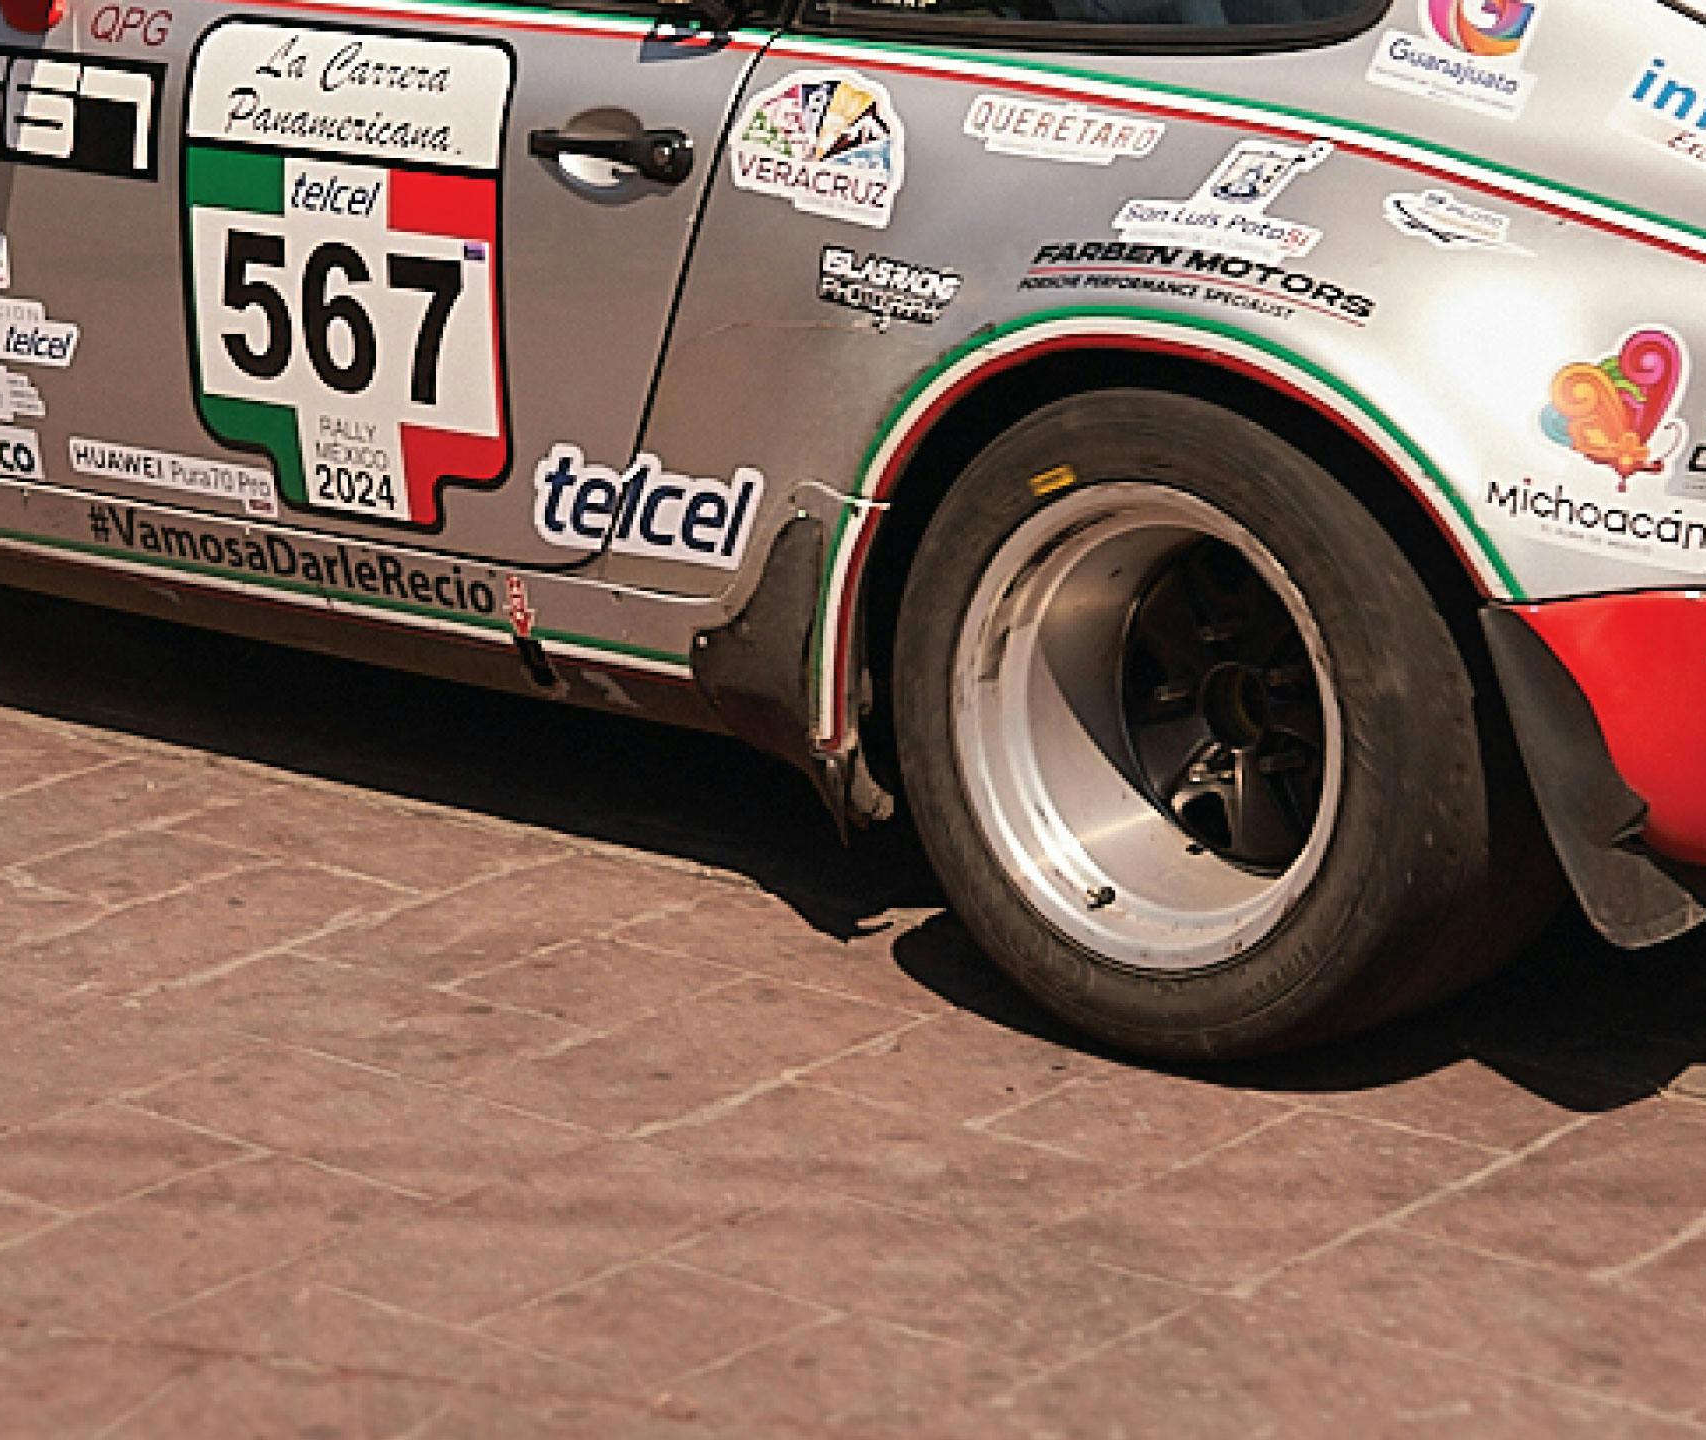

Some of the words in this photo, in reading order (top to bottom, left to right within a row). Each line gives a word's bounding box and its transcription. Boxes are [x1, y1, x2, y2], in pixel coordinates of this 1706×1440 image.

[91, 6, 173, 47] QPG
[255, 35, 307, 78] La
[320, 41, 451, 92] Carrera
[1389, 37, 1519, 96] Guanajuato
[291, 172, 381, 218] telcel
[738, 150, 888, 209] VERACRUZ
[1030, 242, 1184, 266] FARBEN
[1181, 248, 1376, 318] MOTORS
[5, 325, 76, 359] telcel
[221, 228, 462, 405] 567
[75, 445, 162, 480] HUAWEI
[314, 463, 395, 511] 2024
[542, 455, 755, 558] telcel
